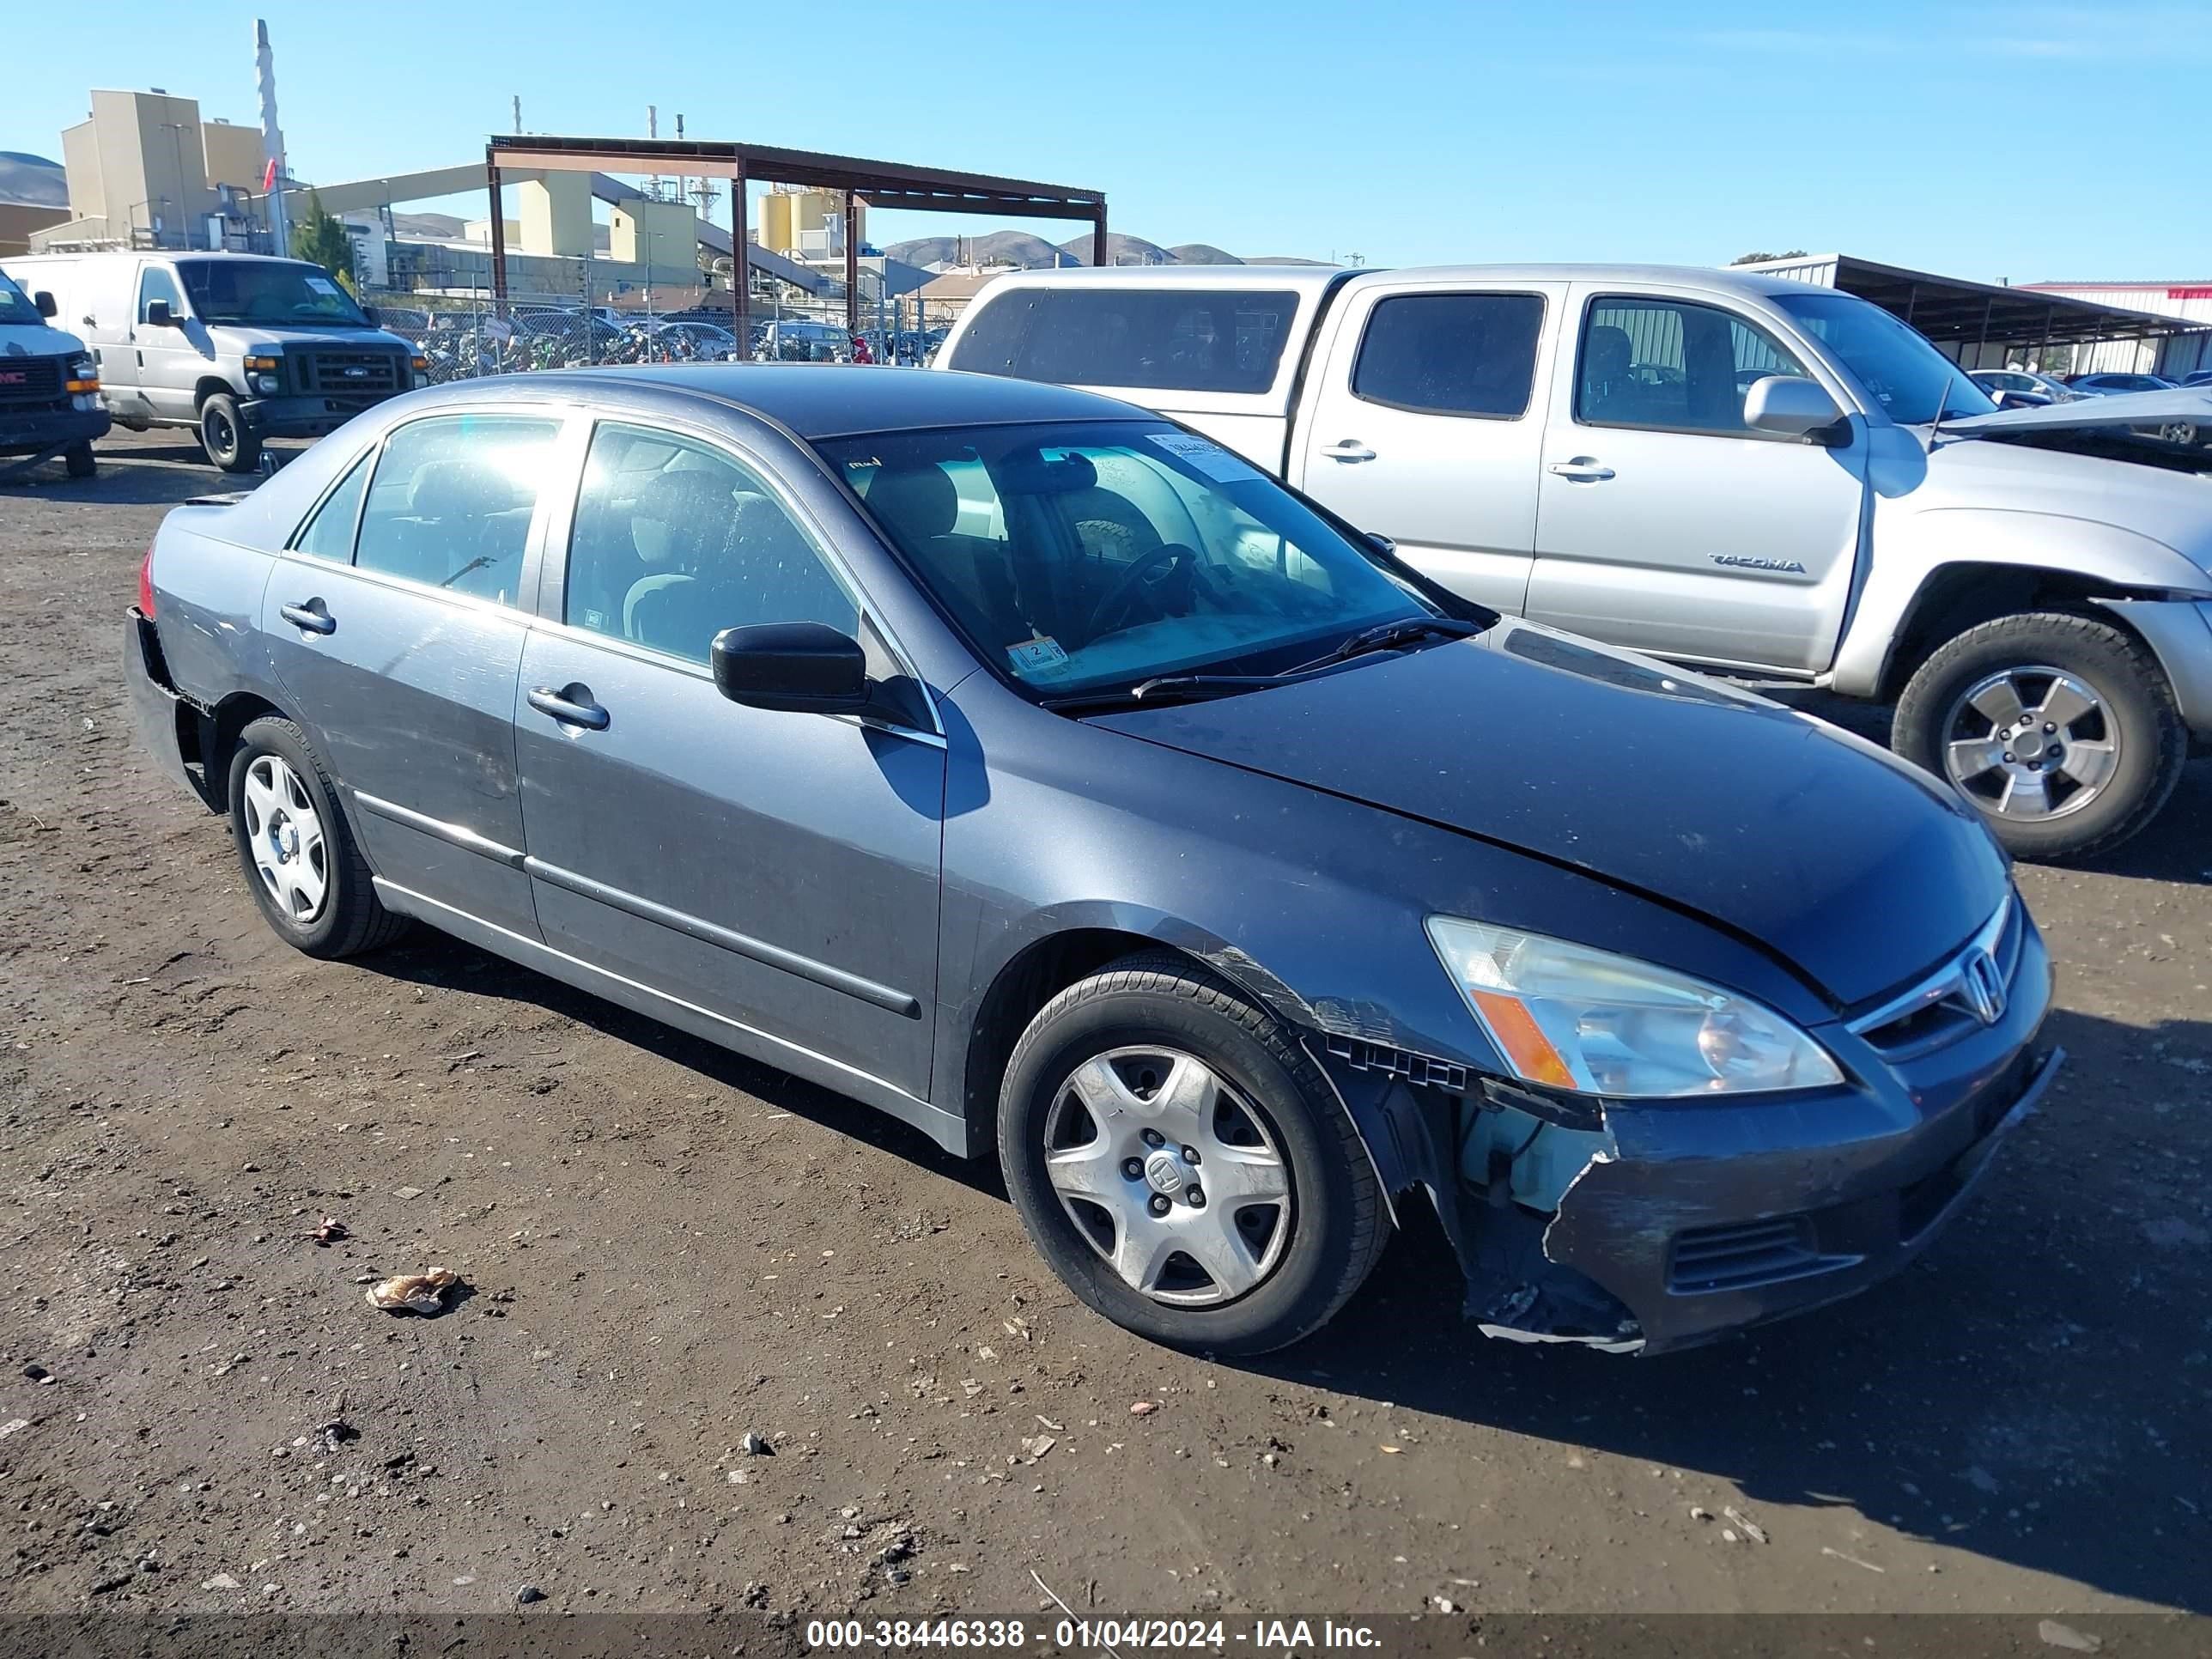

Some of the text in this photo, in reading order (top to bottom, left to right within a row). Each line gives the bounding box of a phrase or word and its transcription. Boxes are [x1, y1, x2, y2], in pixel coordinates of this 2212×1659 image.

[0, 372, 26, 384] MC
[1707, 552, 1807, 574] TACOMA
[1030, 646, 1042, 655] 2
